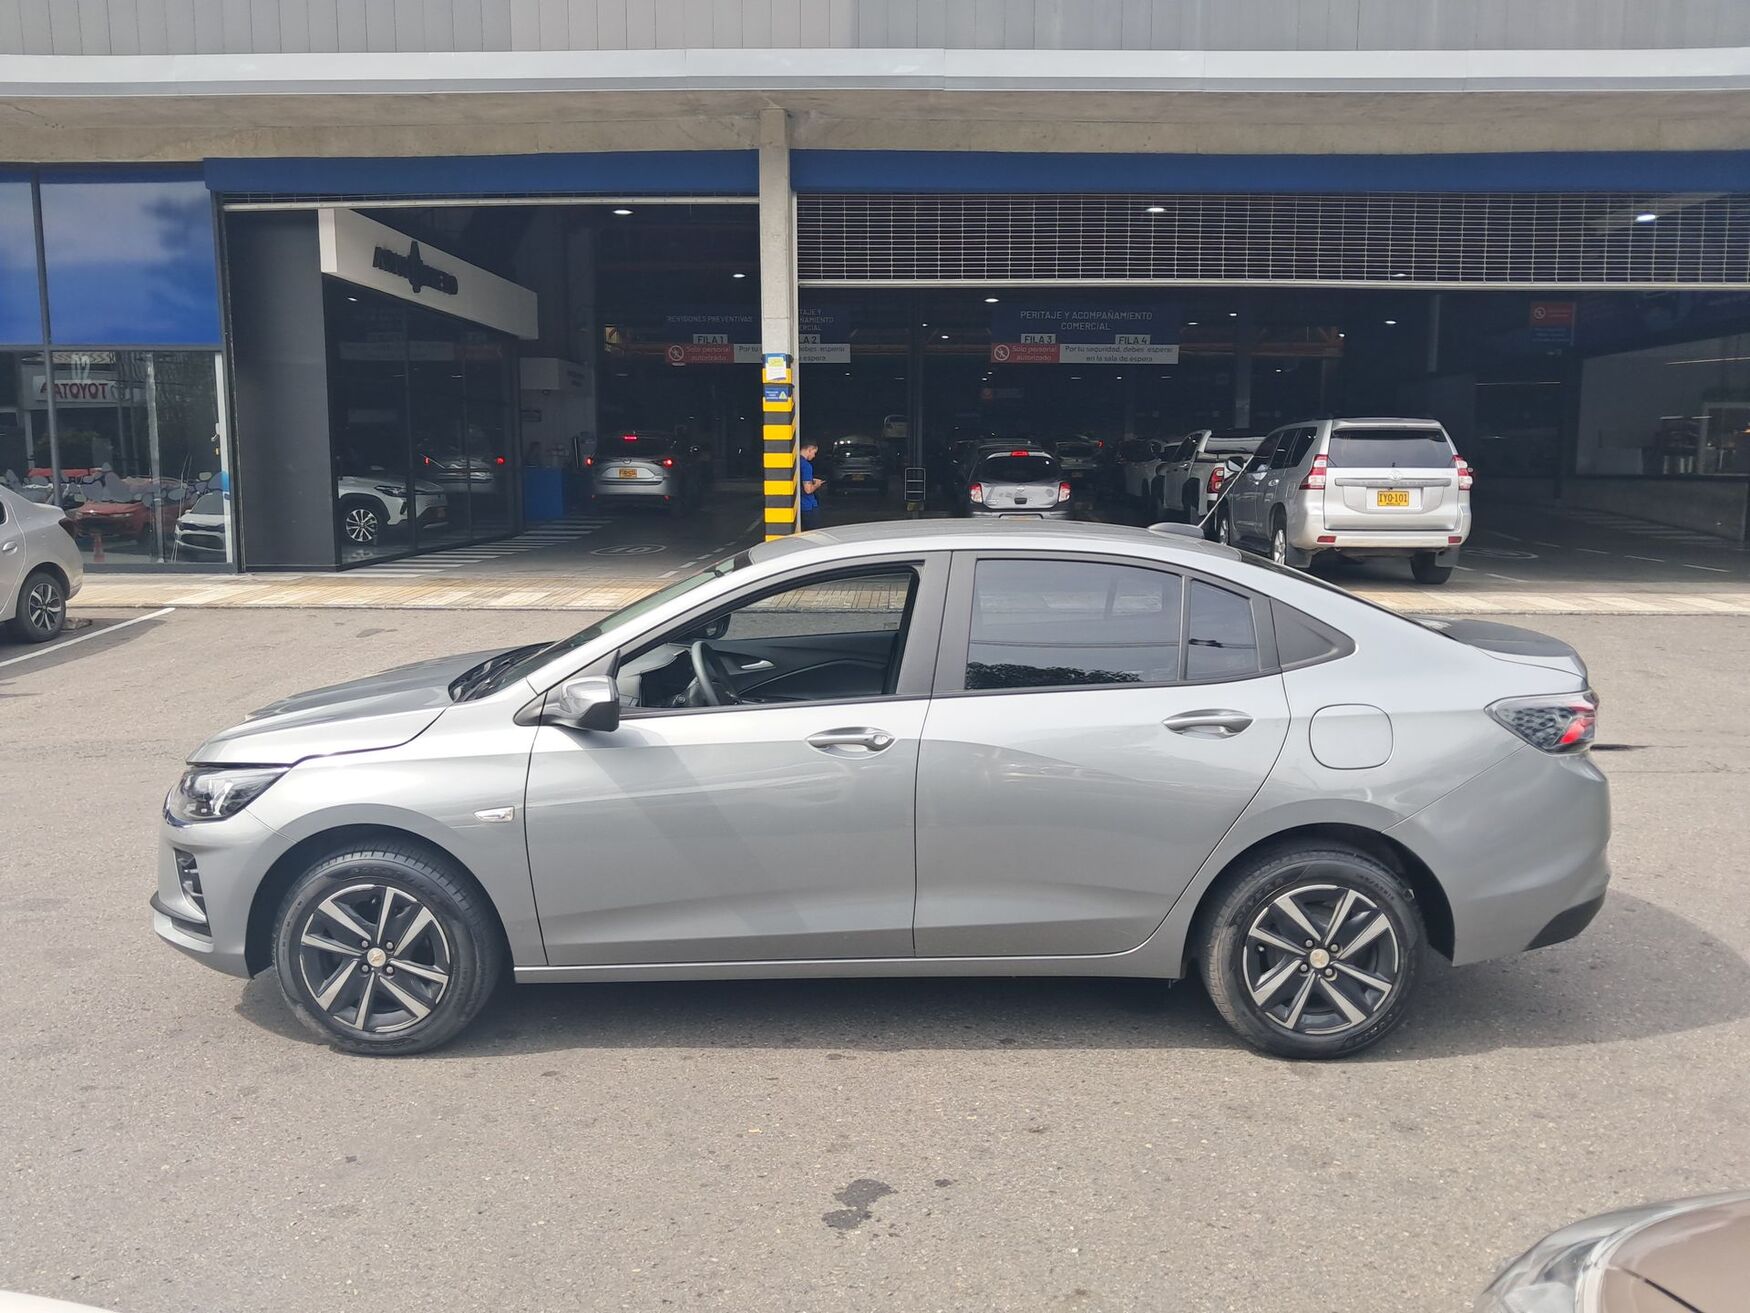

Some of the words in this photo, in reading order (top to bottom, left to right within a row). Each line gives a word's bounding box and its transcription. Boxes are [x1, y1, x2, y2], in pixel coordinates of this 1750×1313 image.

[1020, 311, 1062, 319] PERITAJE
[1064, 311, 1070, 319] Y
[1072, 309, 1153, 320] ACOMPAÑAMIENTO
[1061, 322, 1111, 330] COMERCIAL
[697, 336, 718, 344] FILA
[811, 336, 816, 344] 2
[1024, 336, 1044, 344] FILA
[1047, 336, 1052, 344] 3
[1118, 337, 1139, 345] FILA
[1141, 337, 1147, 345] 4
